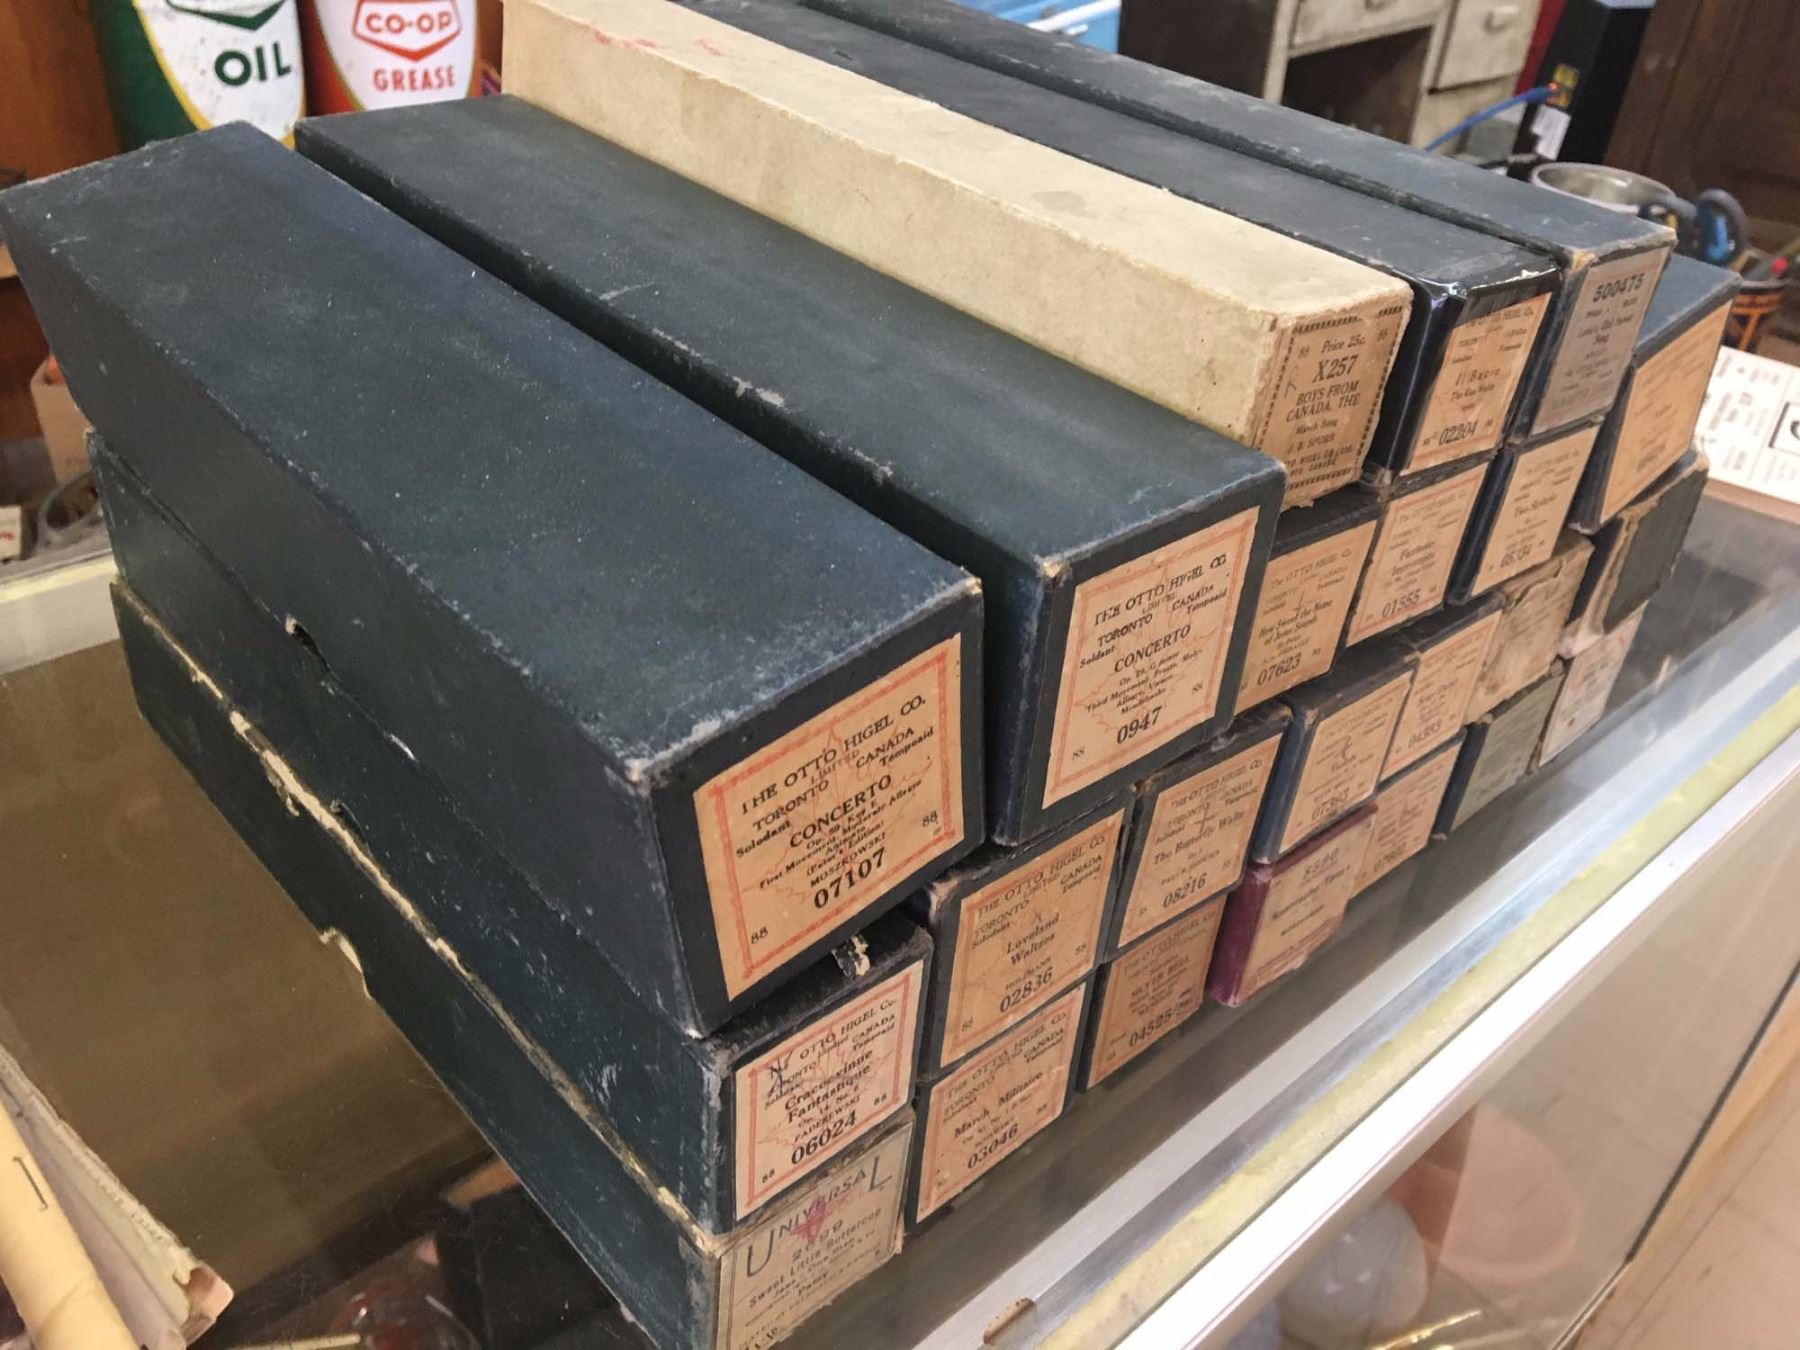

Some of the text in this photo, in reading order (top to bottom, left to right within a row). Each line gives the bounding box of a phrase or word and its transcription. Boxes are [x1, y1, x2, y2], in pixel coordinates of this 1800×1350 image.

[365, 10, 454, 34] CO-OP
[214, 41, 291, 86] OIL
[373, 65, 456, 92] GREASE
[1312, 354, 1359, 383] X257
[1296, 380, 1360, 406] BOYS FROM
[1338, 393, 1360, 408] THE
[1097, 584, 1214, 647] TORONTO CANADA
[1125, 585, 1165, 611] OTTO
[1114, 624, 1190, 673] CONCERTO
[1257, 651, 1302, 686] 07623
[1087, 697, 1108, 712] Third
[1117, 705, 1162, 744] 0947
[742, 695, 925, 815] THE OTTO HIGEL CO.
[753, 727, 914, 831] TORONTO CANADA
[790, 774, 891, 848] CONCERTO
[848, 809, 866, 823] Key
[750, 810, 938, 944] 88 07107 88
[810, 832, 887, 888] MOSZKOWSKI
[1154, 851, 1173, 864] The
[759, 872, 784, 889] First
[974, 855, 1103, 939] TORONTO CANADA
[1005, 872, 1044, 900] OTTO
[1163, 872, 1207, 908] 08216
[1007, 912, 1059, 954] Loveland
[1011, 933, 1055, 966] Waltzes
[1000, 966, 1053, 1013] 02836
[800, 1032, 836, 1060] OTTO
[841, 1008, 877, 1035] HIGEL
[853, 1014, 895, 1043] CANADA
[1024, 1028, 1064, 1058] CANADA
[787, 1065, 870, 1122] Fantastique
[954, 1072, 1043, 1139] March Militaire
[791, 1109, 857, 1165] 06024
[968, 1123, 1018, 1169] 03046
[747, 1156, 893, 1278] UNIVERSAL
[749, 1208, 881, 1308] Sweet Little Buttercup
